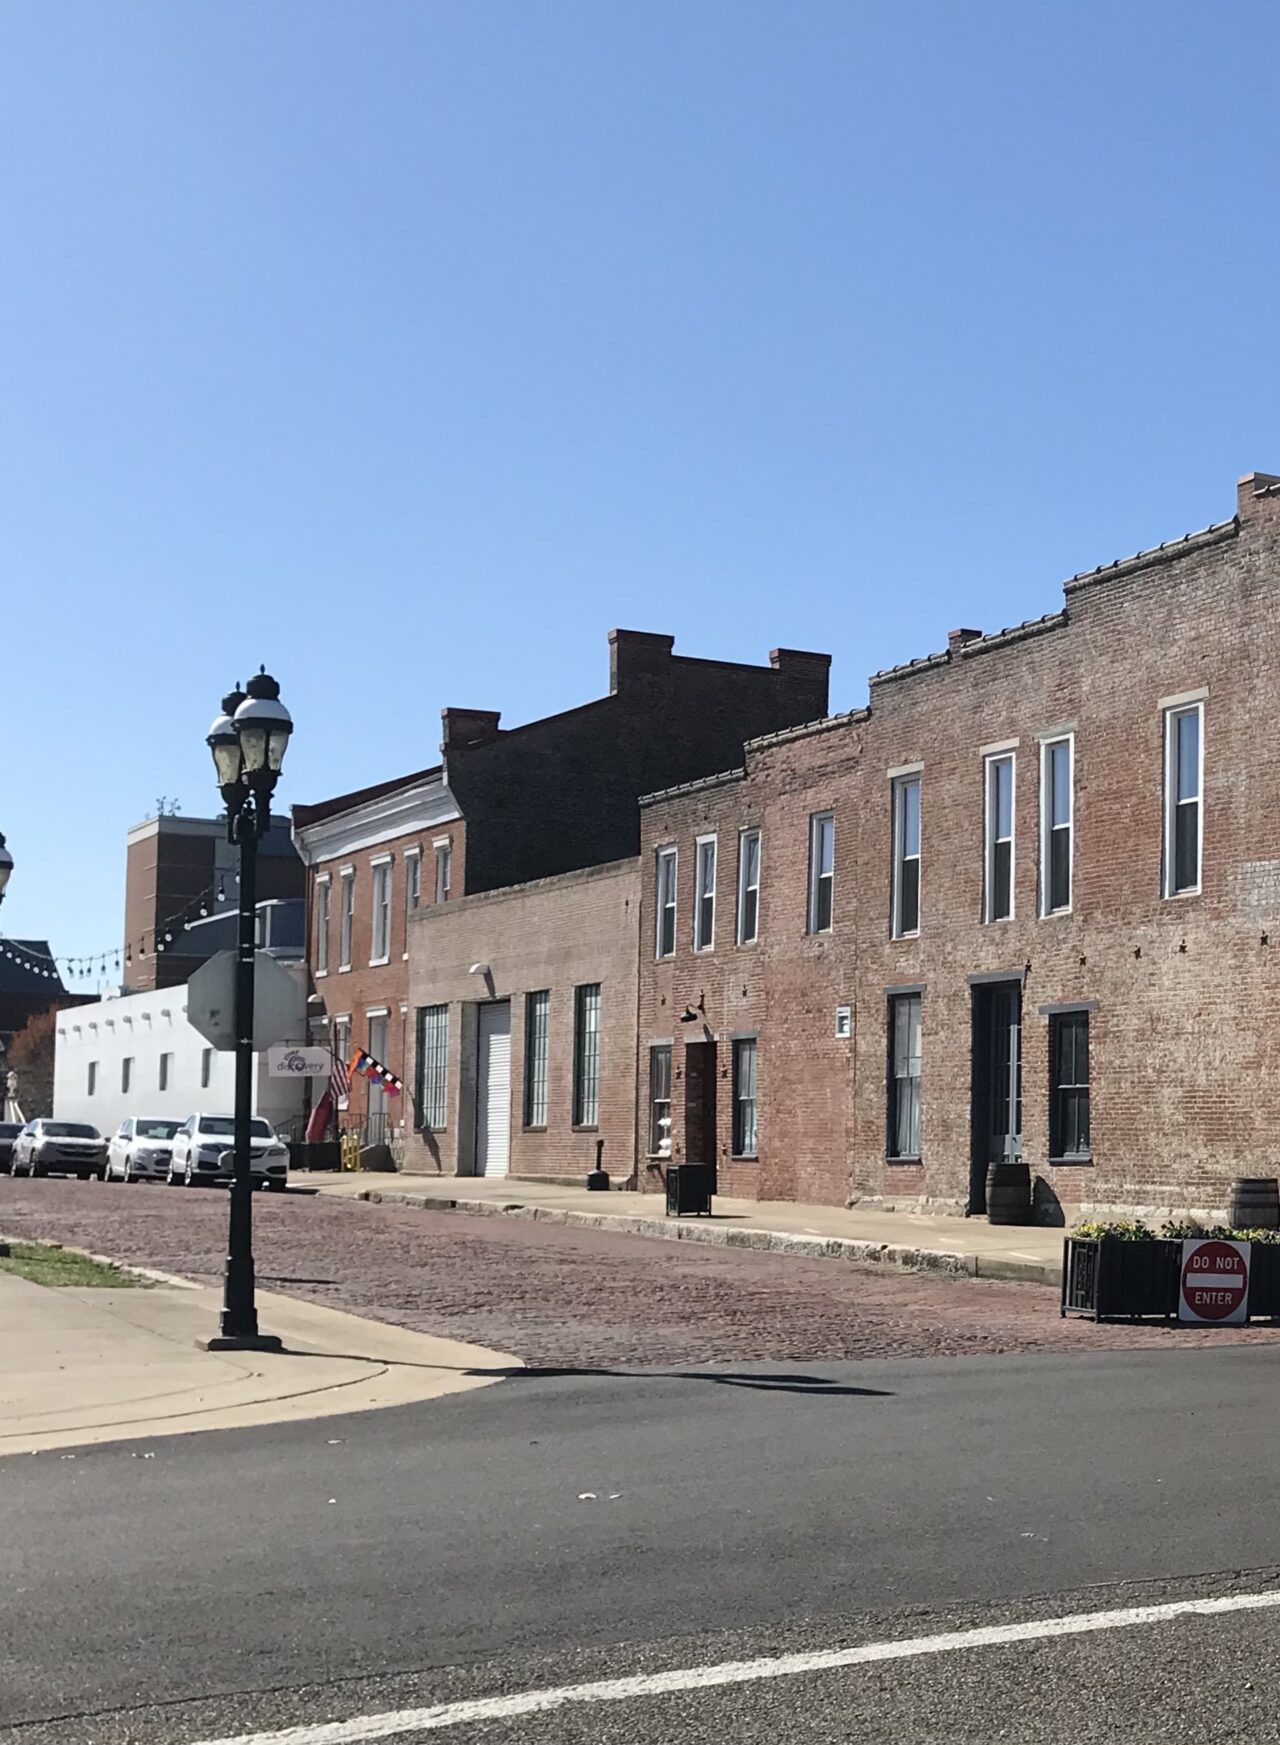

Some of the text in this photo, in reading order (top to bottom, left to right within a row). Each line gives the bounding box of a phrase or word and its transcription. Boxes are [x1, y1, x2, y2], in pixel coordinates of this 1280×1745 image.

[1193, 1256, 1240, 1270] DO NOT
[1195, 1292, 1232, 1305] ENTER
